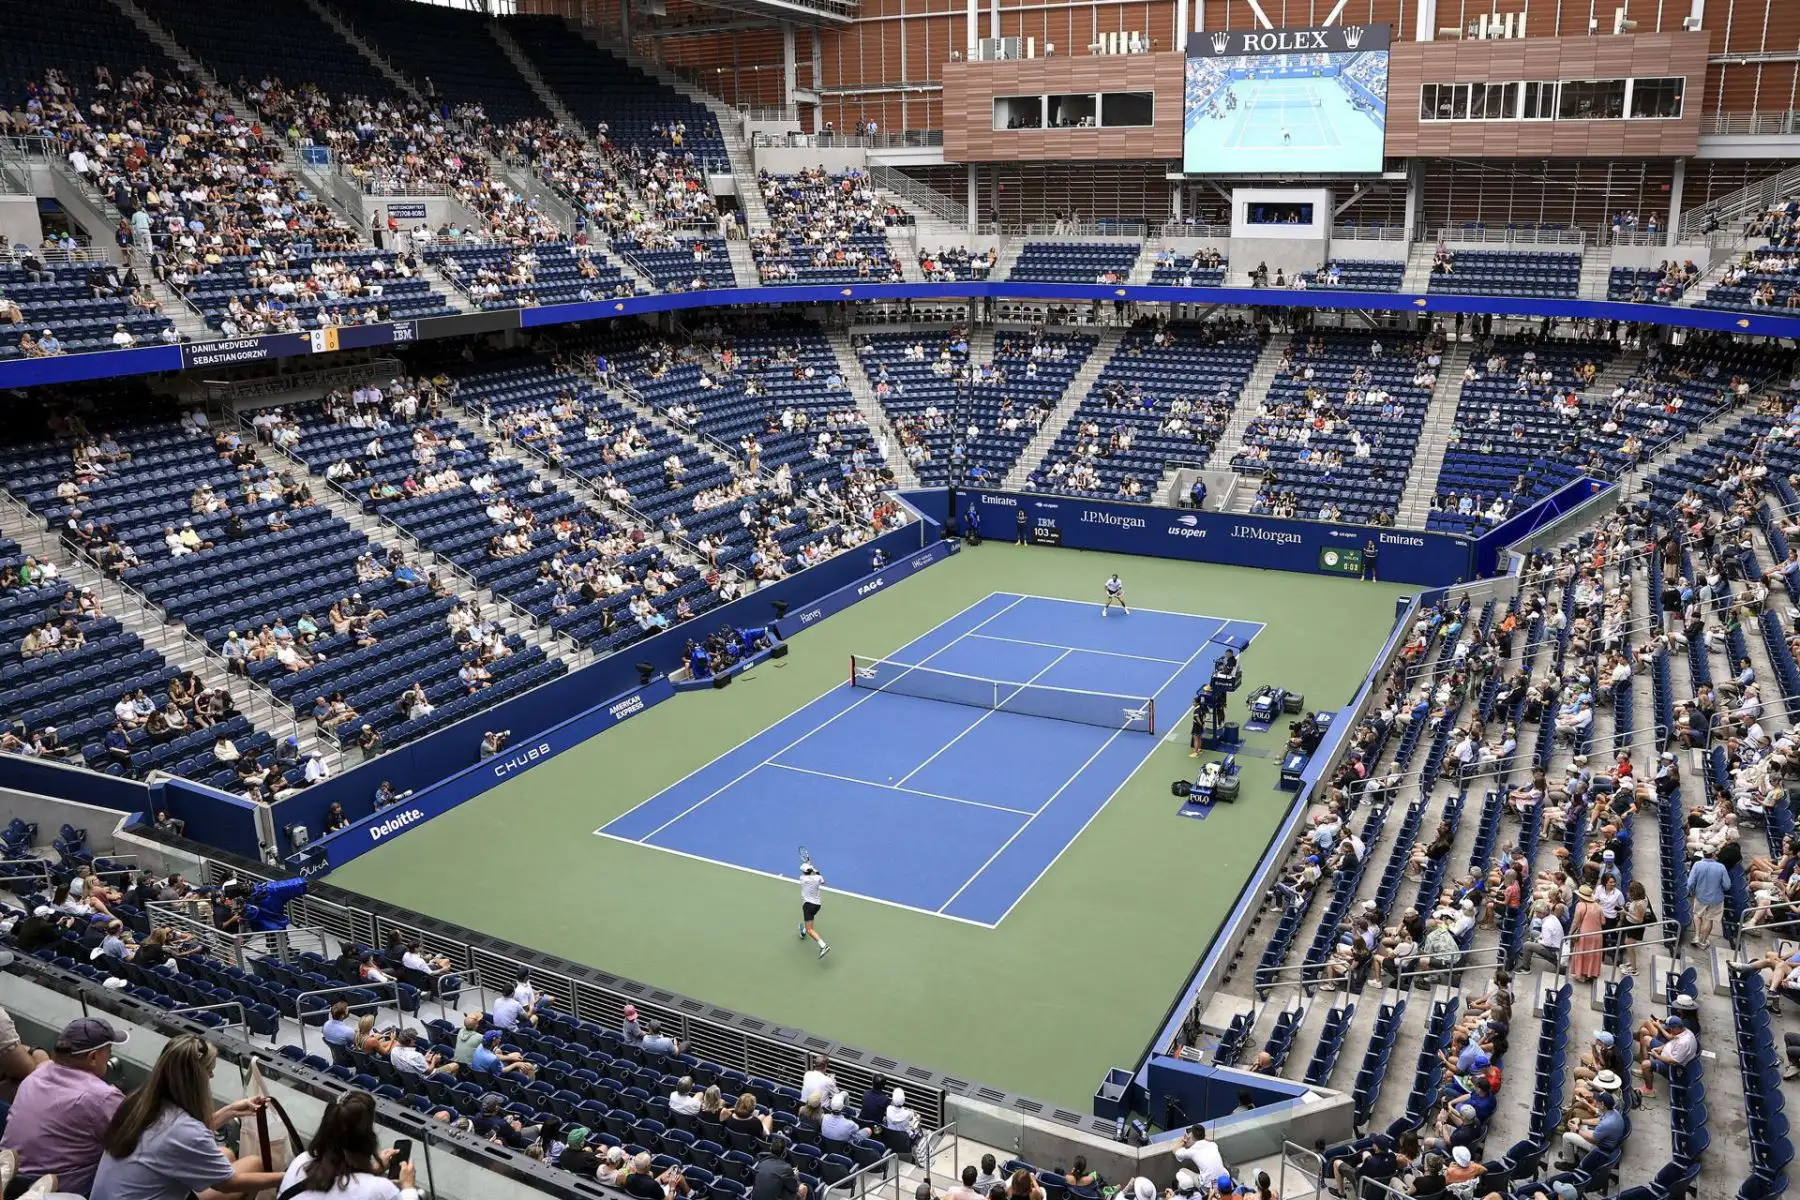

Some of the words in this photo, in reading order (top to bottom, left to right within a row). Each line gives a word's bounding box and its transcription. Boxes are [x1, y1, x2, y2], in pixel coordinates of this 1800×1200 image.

[1242, 31, 1328, 51] ROLEX
[191, 343, 218, 354] DANIIL
[218, 339, 259, 351] MEDVEDEV
[315, 332, 321, 340] 0
[393, 329, 413, 341] IBM
[193, 352, 236, 365] SEBASTIAN
[237, 348, 268, 360] GORZNY
[329, 341, 335, 349] 0
[981, 494, 1017, 507] Emirates
[1037, 517, 1056, 528] IBM
[1080, 510, 1146, 529] J.P.Morgan
[1034, 527, 1049, 537] 103
[1168, 526, 1180, 535] us
[1180, 529, 1206, 538] open
[1231, 525, 1302, 545] J.P.Morgan
[1379, 533, 1424, 546] Emirates
[800, 608, 822, 624] Harvey
[609, 695, 641, 715] AMERICAN
[615, 701, 644, 719] EXPRESS
[494, 743, 551, 777] CHUBB
[1190, 793, 1210, 805] POLO
[369, 807, 425, 841] Deloitte.
